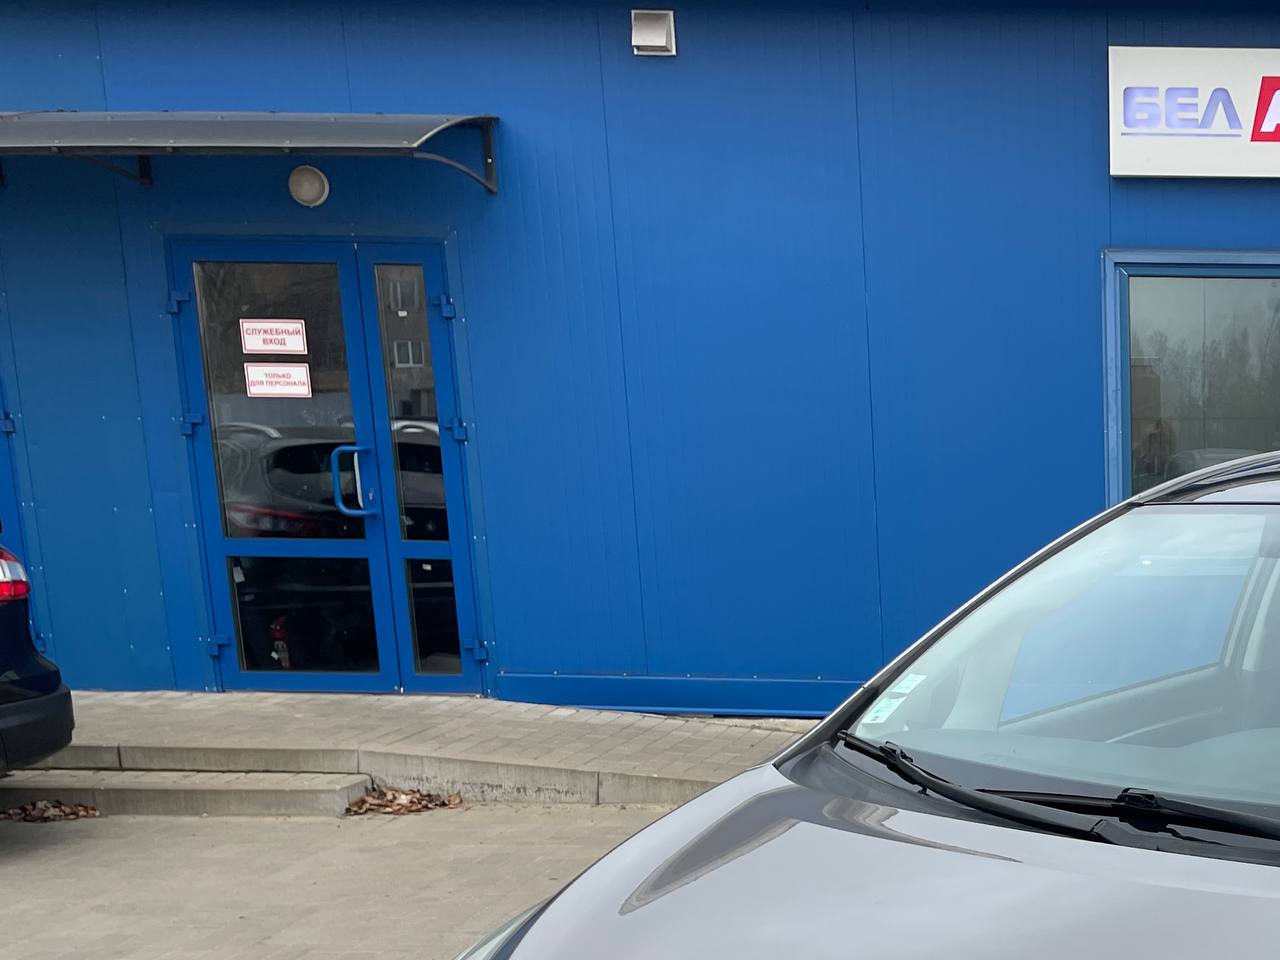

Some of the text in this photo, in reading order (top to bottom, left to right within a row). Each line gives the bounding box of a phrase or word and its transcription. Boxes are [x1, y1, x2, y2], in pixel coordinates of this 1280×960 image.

[1122, 86, 1242, 130] БЕЛ
[245, 327, 301, 336] СЛУЖЕБНЫЙ
[262, 337, 287, 346] ВХОД
